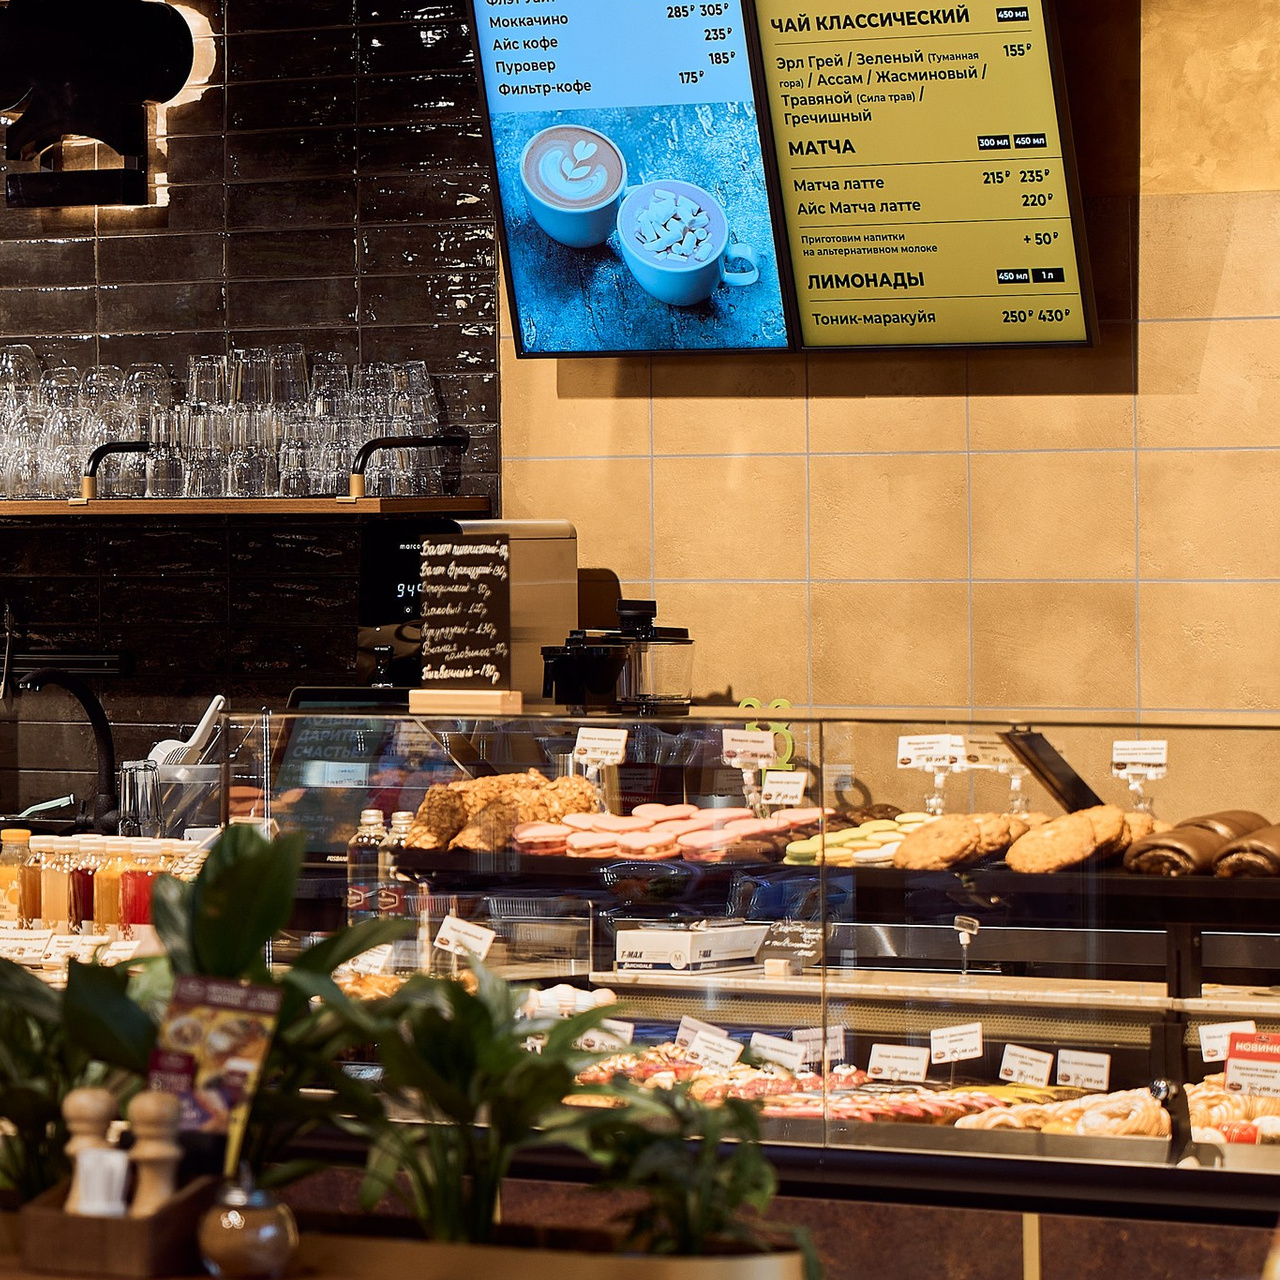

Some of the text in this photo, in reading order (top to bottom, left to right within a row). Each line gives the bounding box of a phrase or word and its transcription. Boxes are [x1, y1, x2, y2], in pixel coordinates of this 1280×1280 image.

[490, 15, 568, 28] Моккачино
[771, 14, 810, 32] ЧАЙ
[816, 4, 969, 30] КЛАССИЧЕСКИЙ
[997, 10, 1014, 19] 450
[493, 38, 519, 50] Айс
[523, 36, 557, 51] кофе
[496, 61, 555, 75] Пуровер
[776, 58, 804, 72] Эрл
[808, 54, 843, 70] Грей
[857, 50, 923, 65] Зеленый
[928, 53, 978, 63] (Туманная
[780, 79, 803, 89] гора)
[818, 74, 863, 86] Ассам
[876, 66, 977, 83] Жасминовый
[499, 80, 591, 96] Фильтр-кофе
[781, 91, 852, 109] Травяной
[857, 94, 885, 105] (Сила
[888, 92, 915, 103] трав)
[784, 112, 871, 127] Гречишный
[789, 139, 855, 156] МАТЧА
[979, 138, 996, 147] 300
[1015, 136, 1032, 145] 450
[794, 180, 839, 192] Матча
[844, 179, 884, 190] латте
[798, 202, 825, 215] Айс
[830, 202, 875, 214] Матча
[880, 202, 920, 212] латте
[801, 236, 861, 245] Приготовим
[817, 247, 898, 256] альтернативном
[808, 272, 924, 289] ЛИМОНАДЫ
[998, 272, 1015, 280] 450
[812, 310, 935, 326] Тоник-маракуйя
[621, 951, 644, 959] T-MAX
